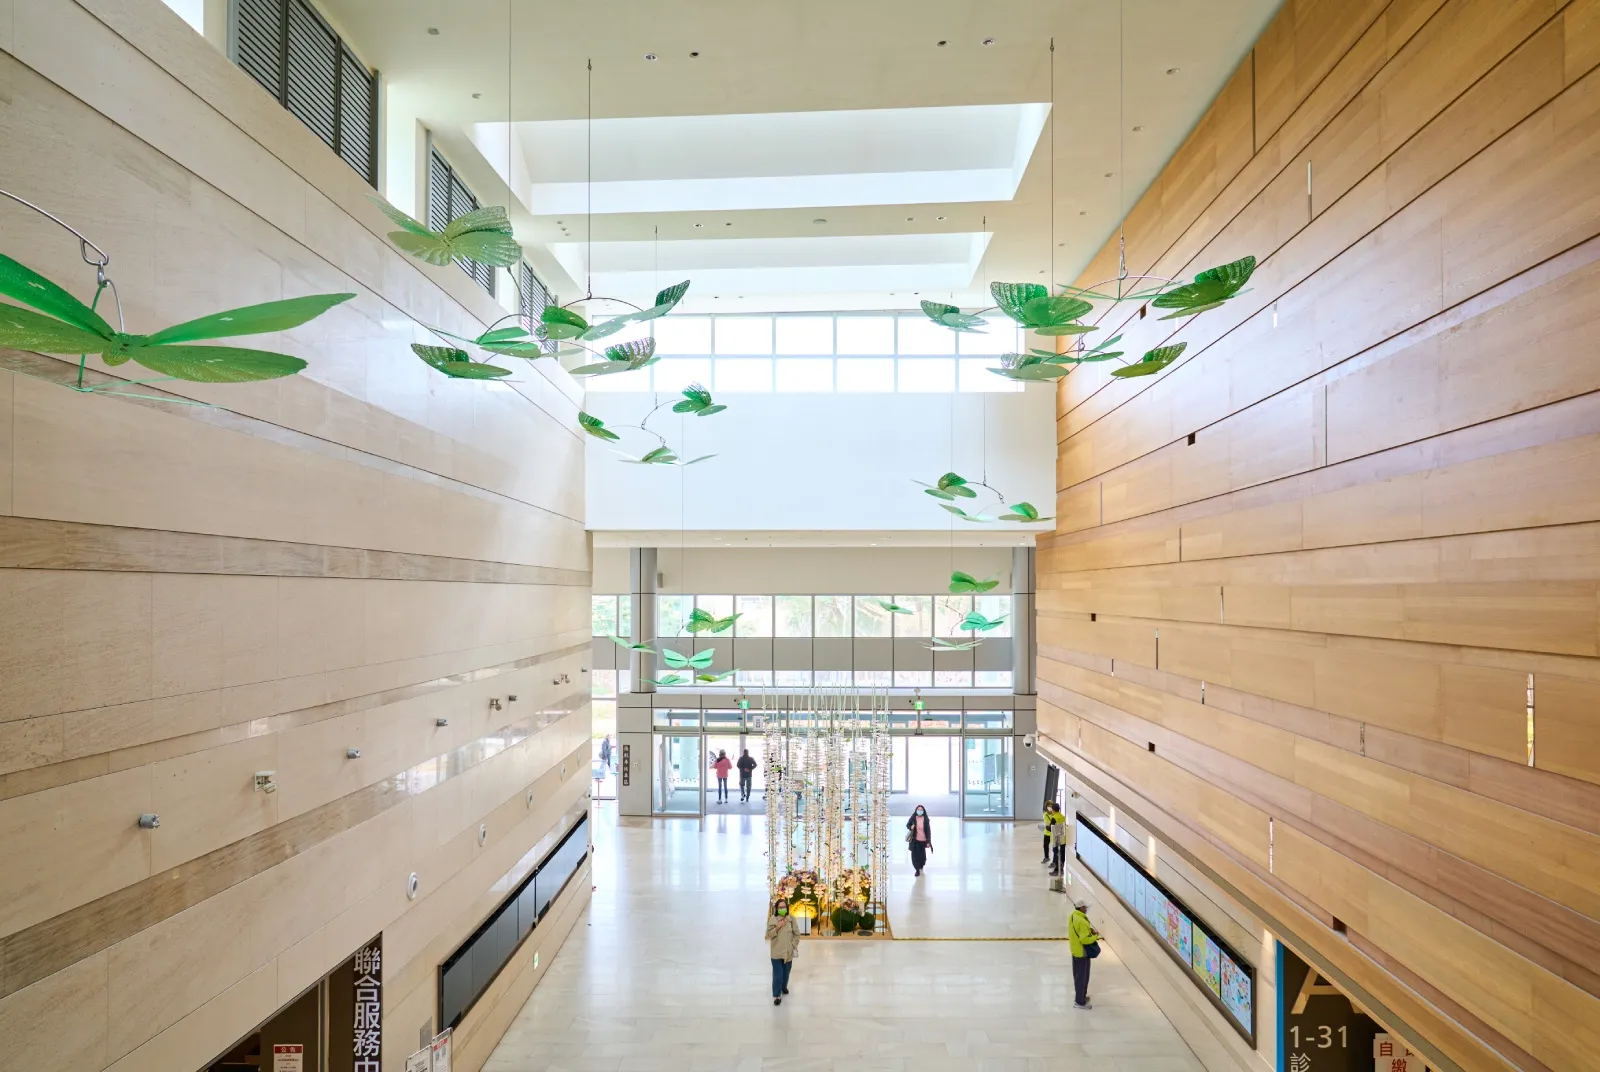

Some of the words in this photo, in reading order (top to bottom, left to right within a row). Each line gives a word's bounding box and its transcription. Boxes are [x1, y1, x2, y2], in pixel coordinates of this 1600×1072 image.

[353, 948, 381, 1072] 聯合服務中
[1290, 1026, 1347, 1048] 1-31
[1290, 1053, 1311, 1072] 診
